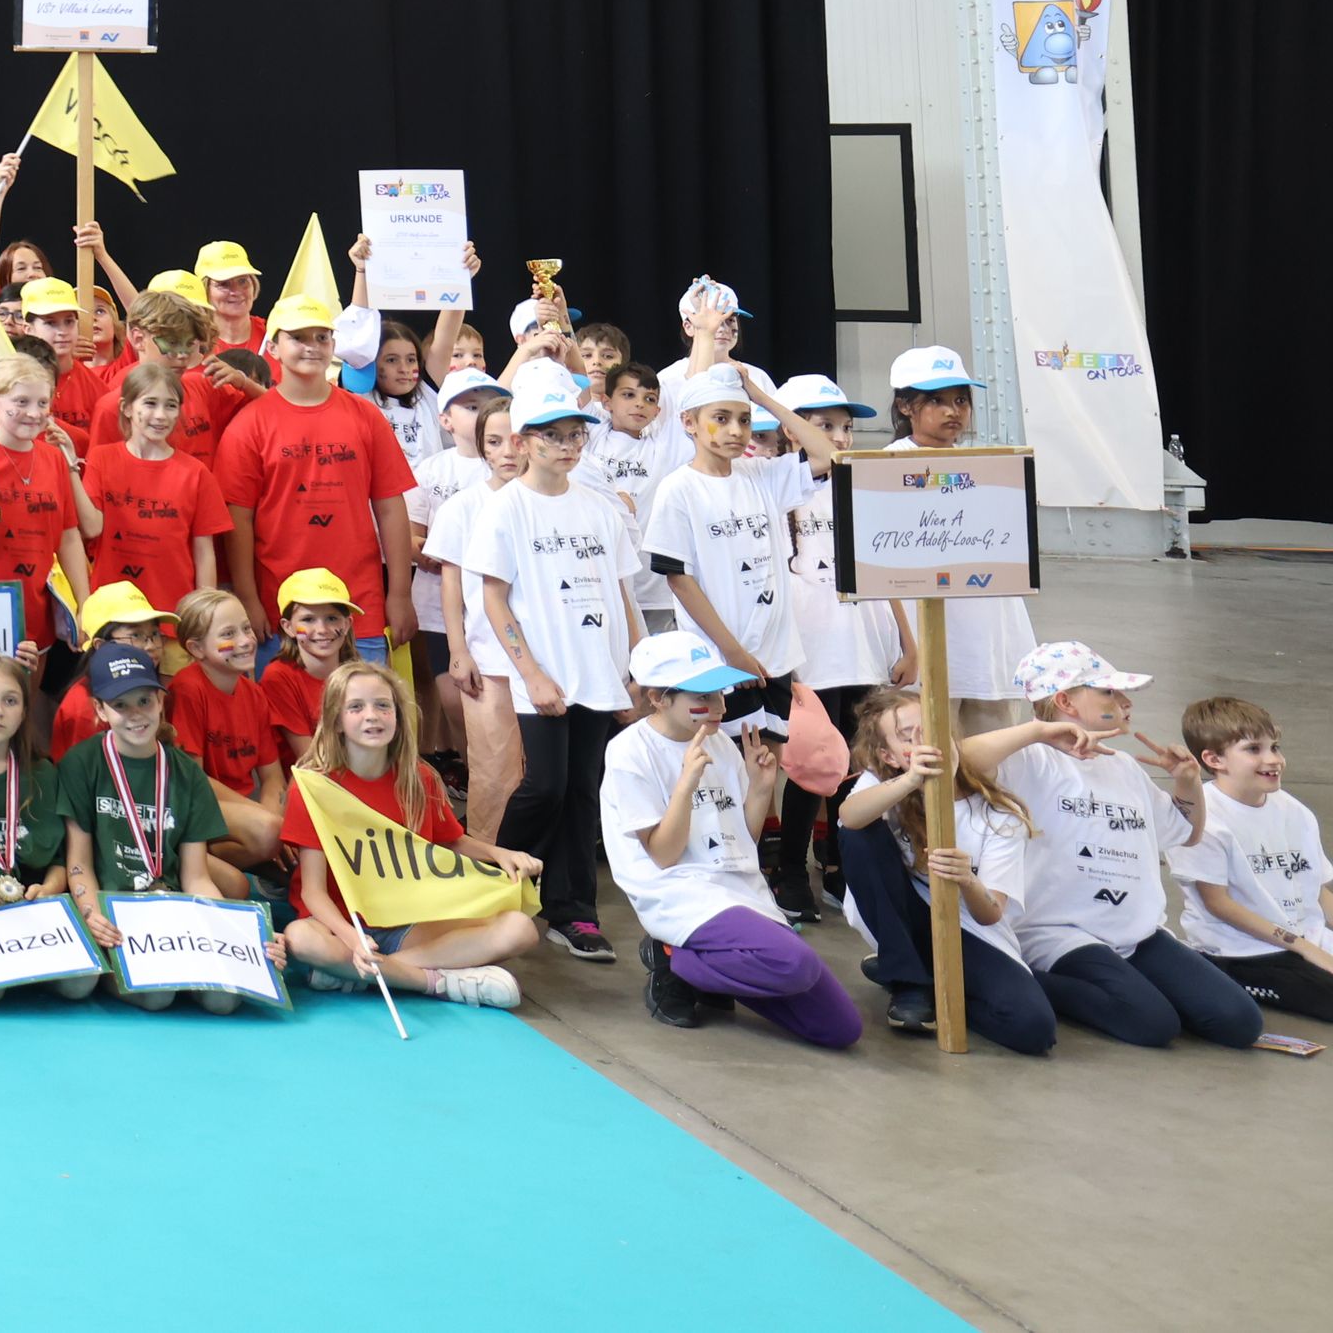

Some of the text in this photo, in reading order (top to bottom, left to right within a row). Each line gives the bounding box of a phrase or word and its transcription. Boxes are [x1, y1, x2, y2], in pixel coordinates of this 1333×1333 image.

[59, 2, 88, 14] Villach
[92, 3, 133, 14] Landskron
[389, 214, 443, 223] URKUNDE
[1087, 364, 1144, 381] ON TOUR
[919, 509, 964, 528] Wien A
[872, 529, 1011, 553] GTVS Adolf-Loos-G. 2
[334, 827, 502, 881] villa
[1097, 847, 1139, 861] Zivilschutz
[127, 932, 261, 967] Mariazell
